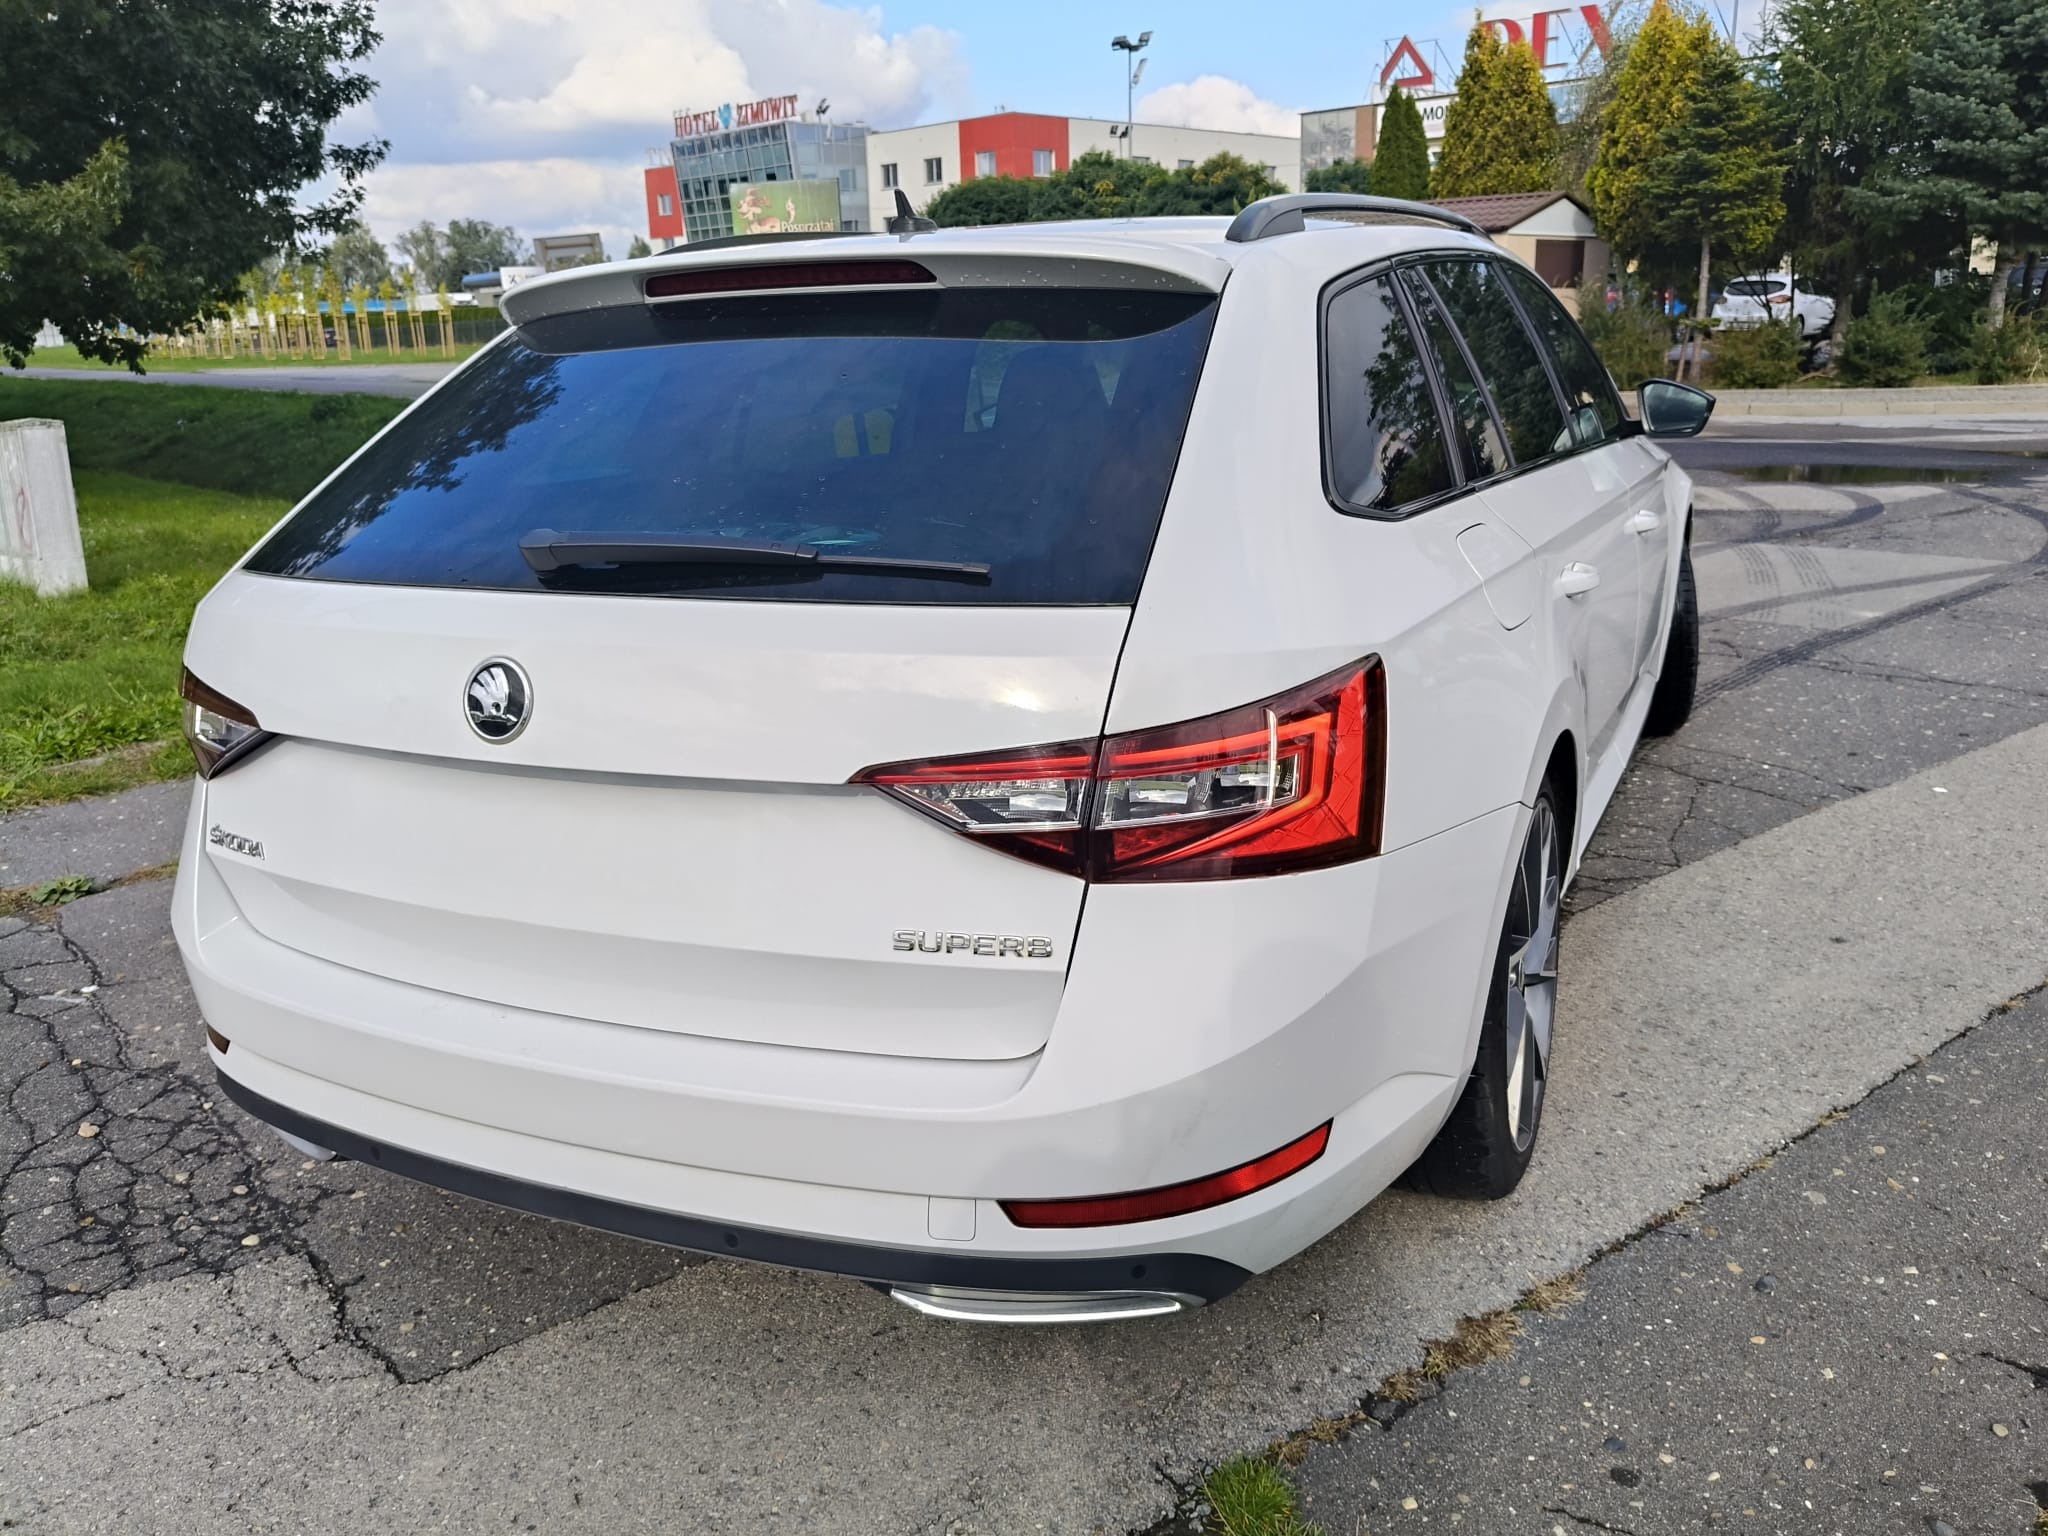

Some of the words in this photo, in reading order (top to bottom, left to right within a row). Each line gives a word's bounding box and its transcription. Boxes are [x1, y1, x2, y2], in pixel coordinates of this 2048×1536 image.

[674, 111, 719, 137] HOTEL
[737, 94, 798, 127] ZIMOWIT
[893, 929, 1053, 958] SUPERB
